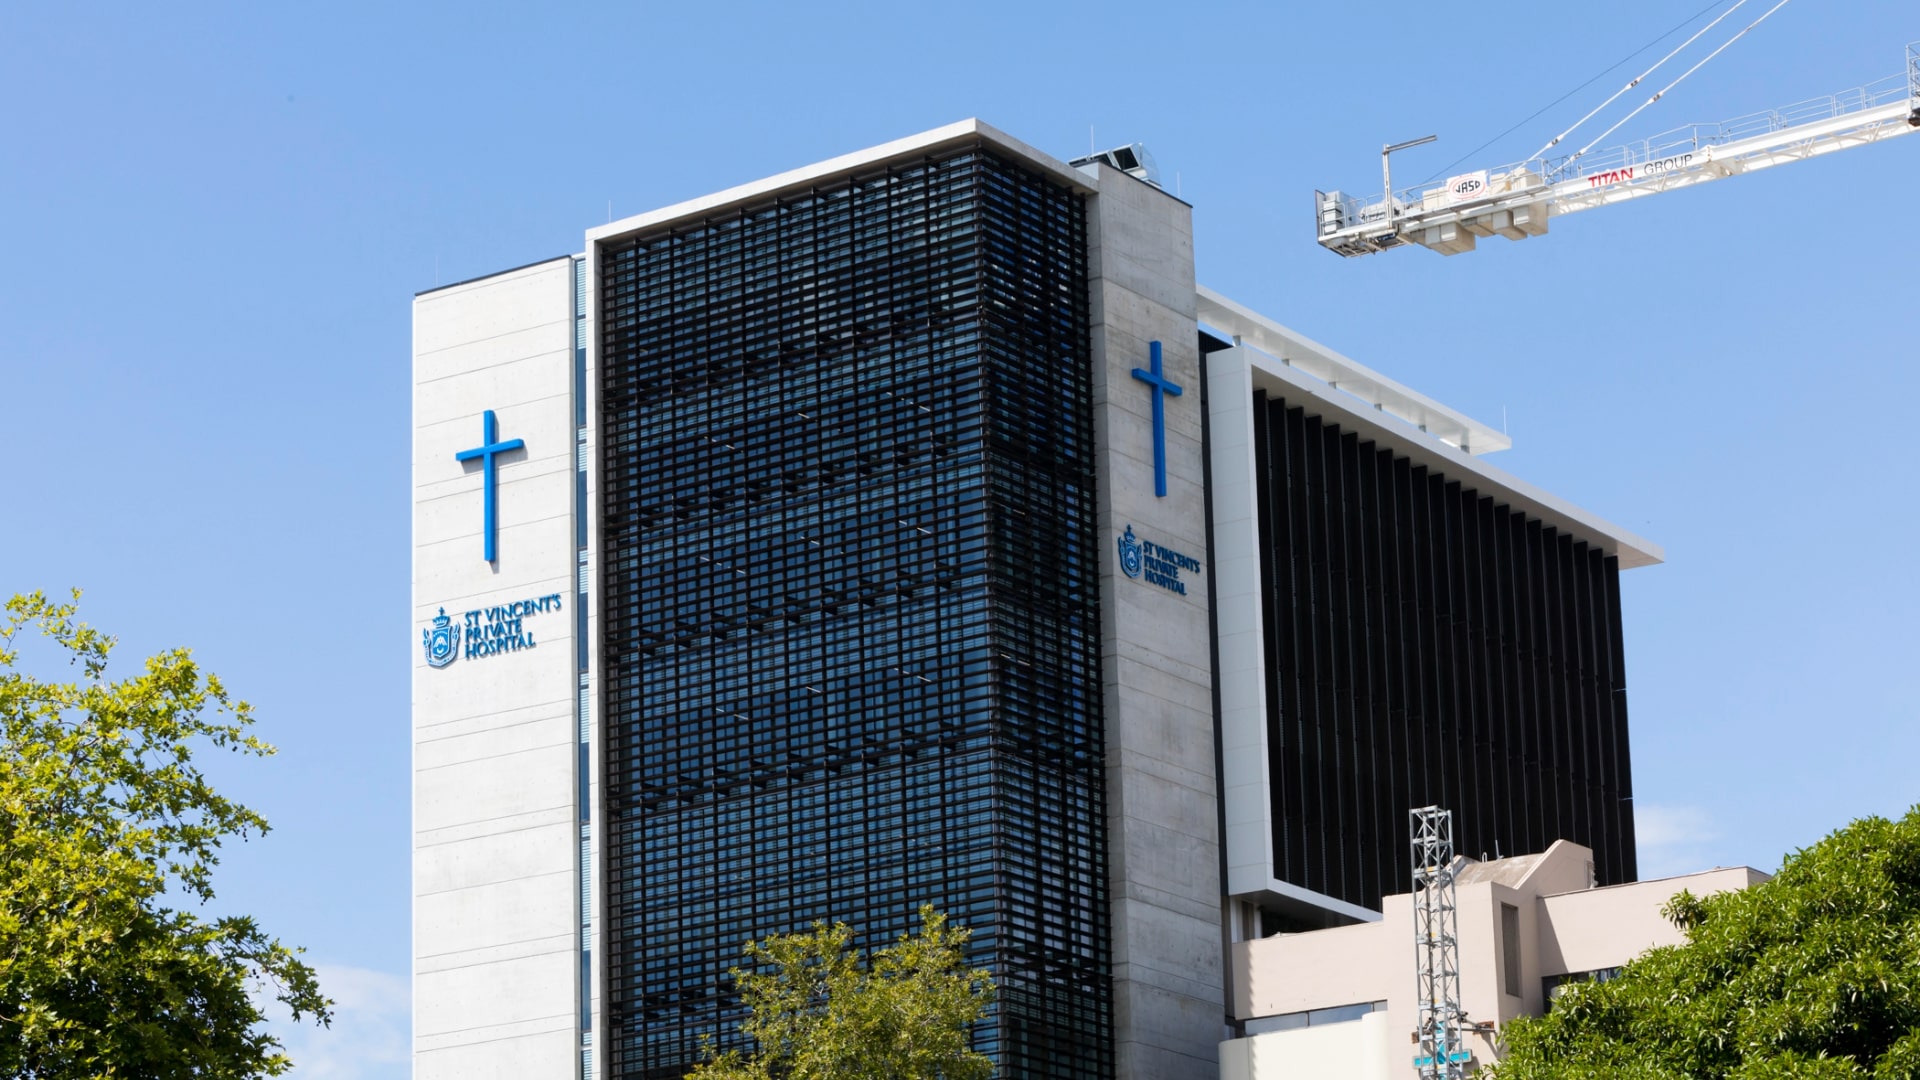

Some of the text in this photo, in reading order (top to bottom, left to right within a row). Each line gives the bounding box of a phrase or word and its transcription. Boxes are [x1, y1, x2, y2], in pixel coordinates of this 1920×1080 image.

[1588, 154, 1693, 187] TITAN GROUP
[1143, 541, 1200, 573] ST VINCENT'S
[1144, 555, 1179, 578] PRIVATE
[1144, 569, 1187, 596] HOSPITAL
[464, 593, 562, 627] ST VINCENT'S
[465, 618, 522, 643] PRIVATE
[465, 632, 536, 659] HOSPITAL
